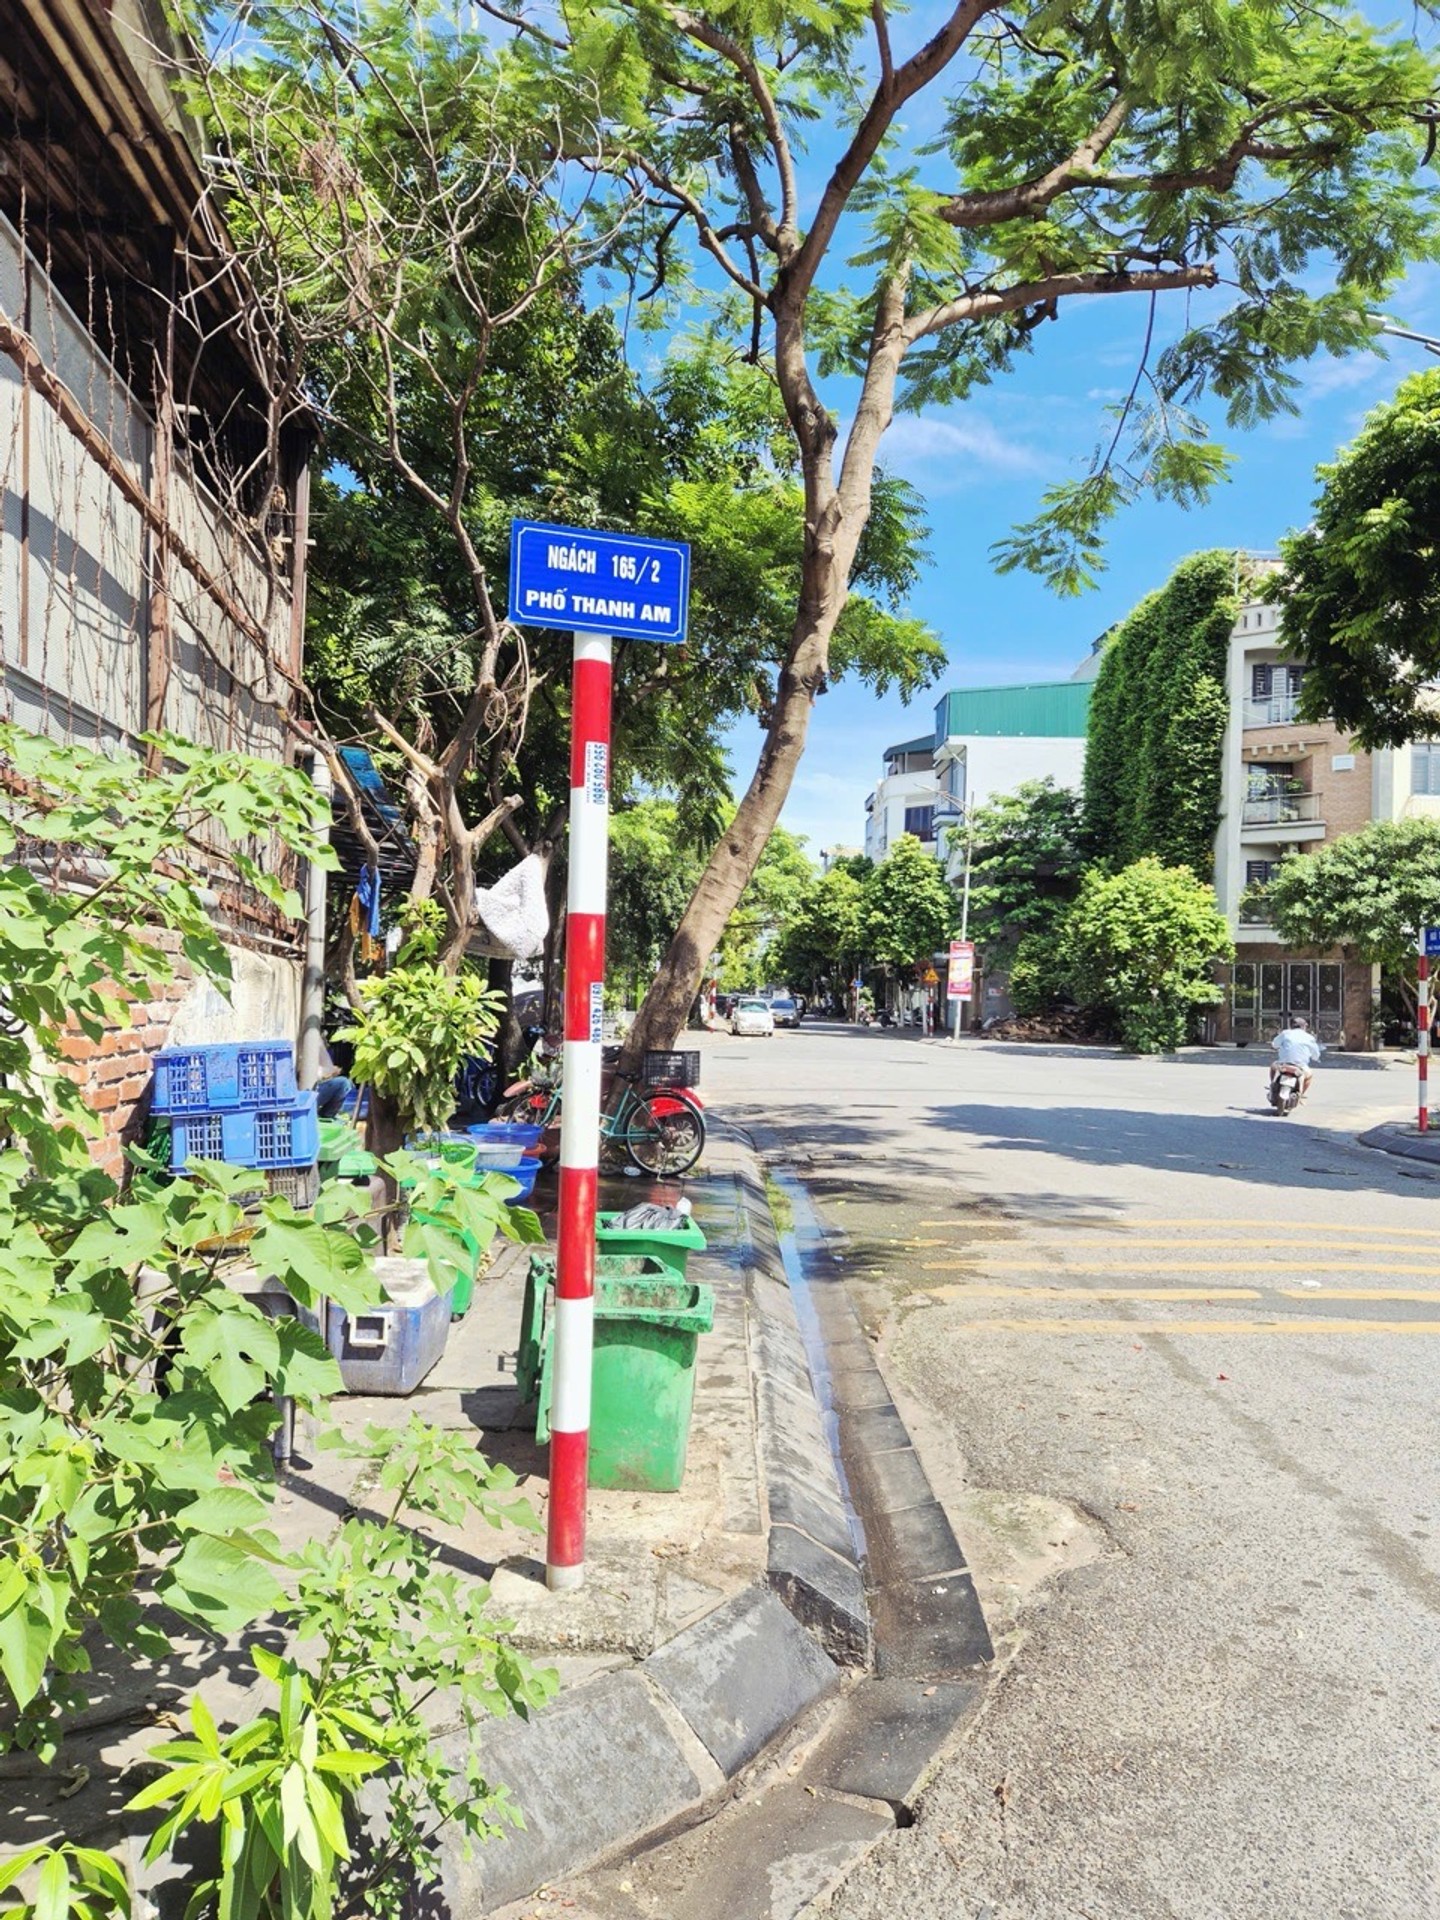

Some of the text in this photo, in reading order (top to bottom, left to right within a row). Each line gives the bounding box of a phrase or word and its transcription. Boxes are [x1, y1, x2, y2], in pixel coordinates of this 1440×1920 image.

[547, 542, 661, 585] NGÁCH 165/2
[526, 587, 671, 624] PHỐ THANH AM
